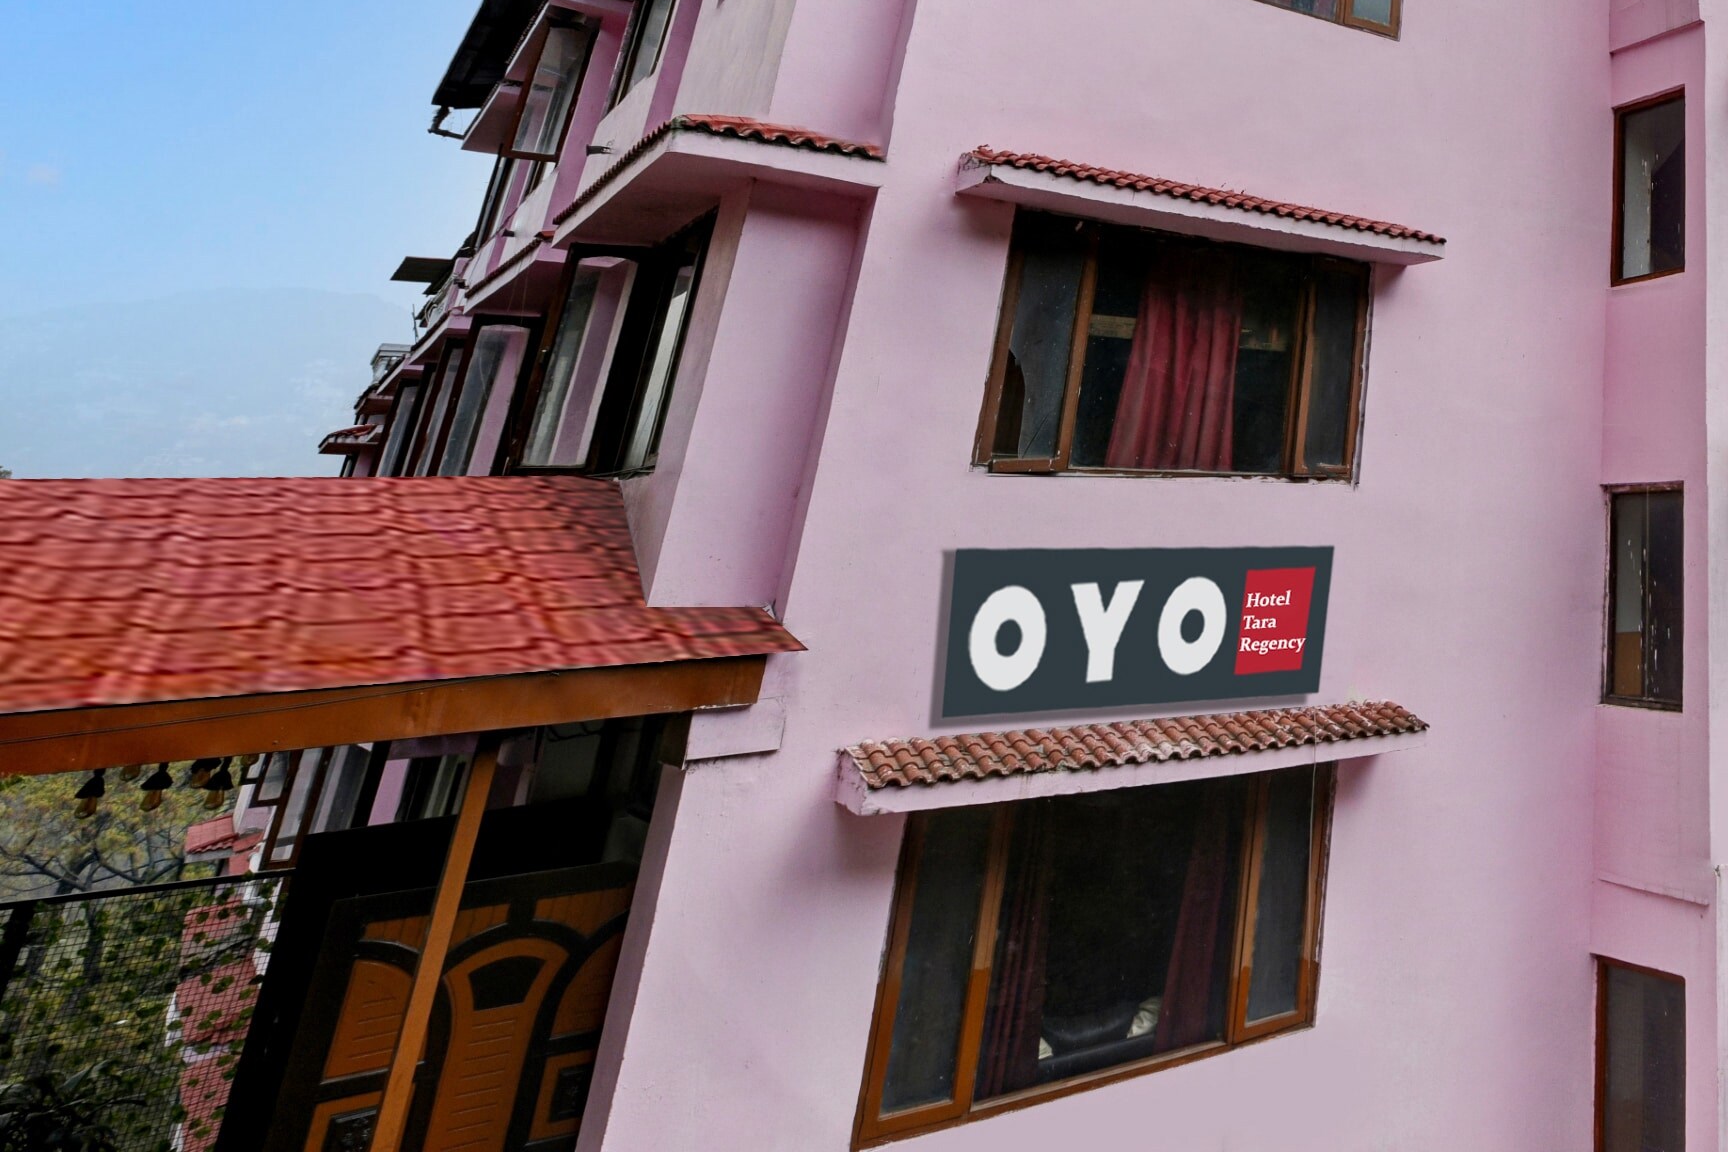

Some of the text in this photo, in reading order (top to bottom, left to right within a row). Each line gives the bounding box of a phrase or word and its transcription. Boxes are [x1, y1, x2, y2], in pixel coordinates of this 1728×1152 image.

[1246, 590, 1291, 608] Hotel
[1243, 615, 1277, 630] Tara
[969, 577, 1227, 691] OYO
[1239, 637, 1306, 655] Regency
